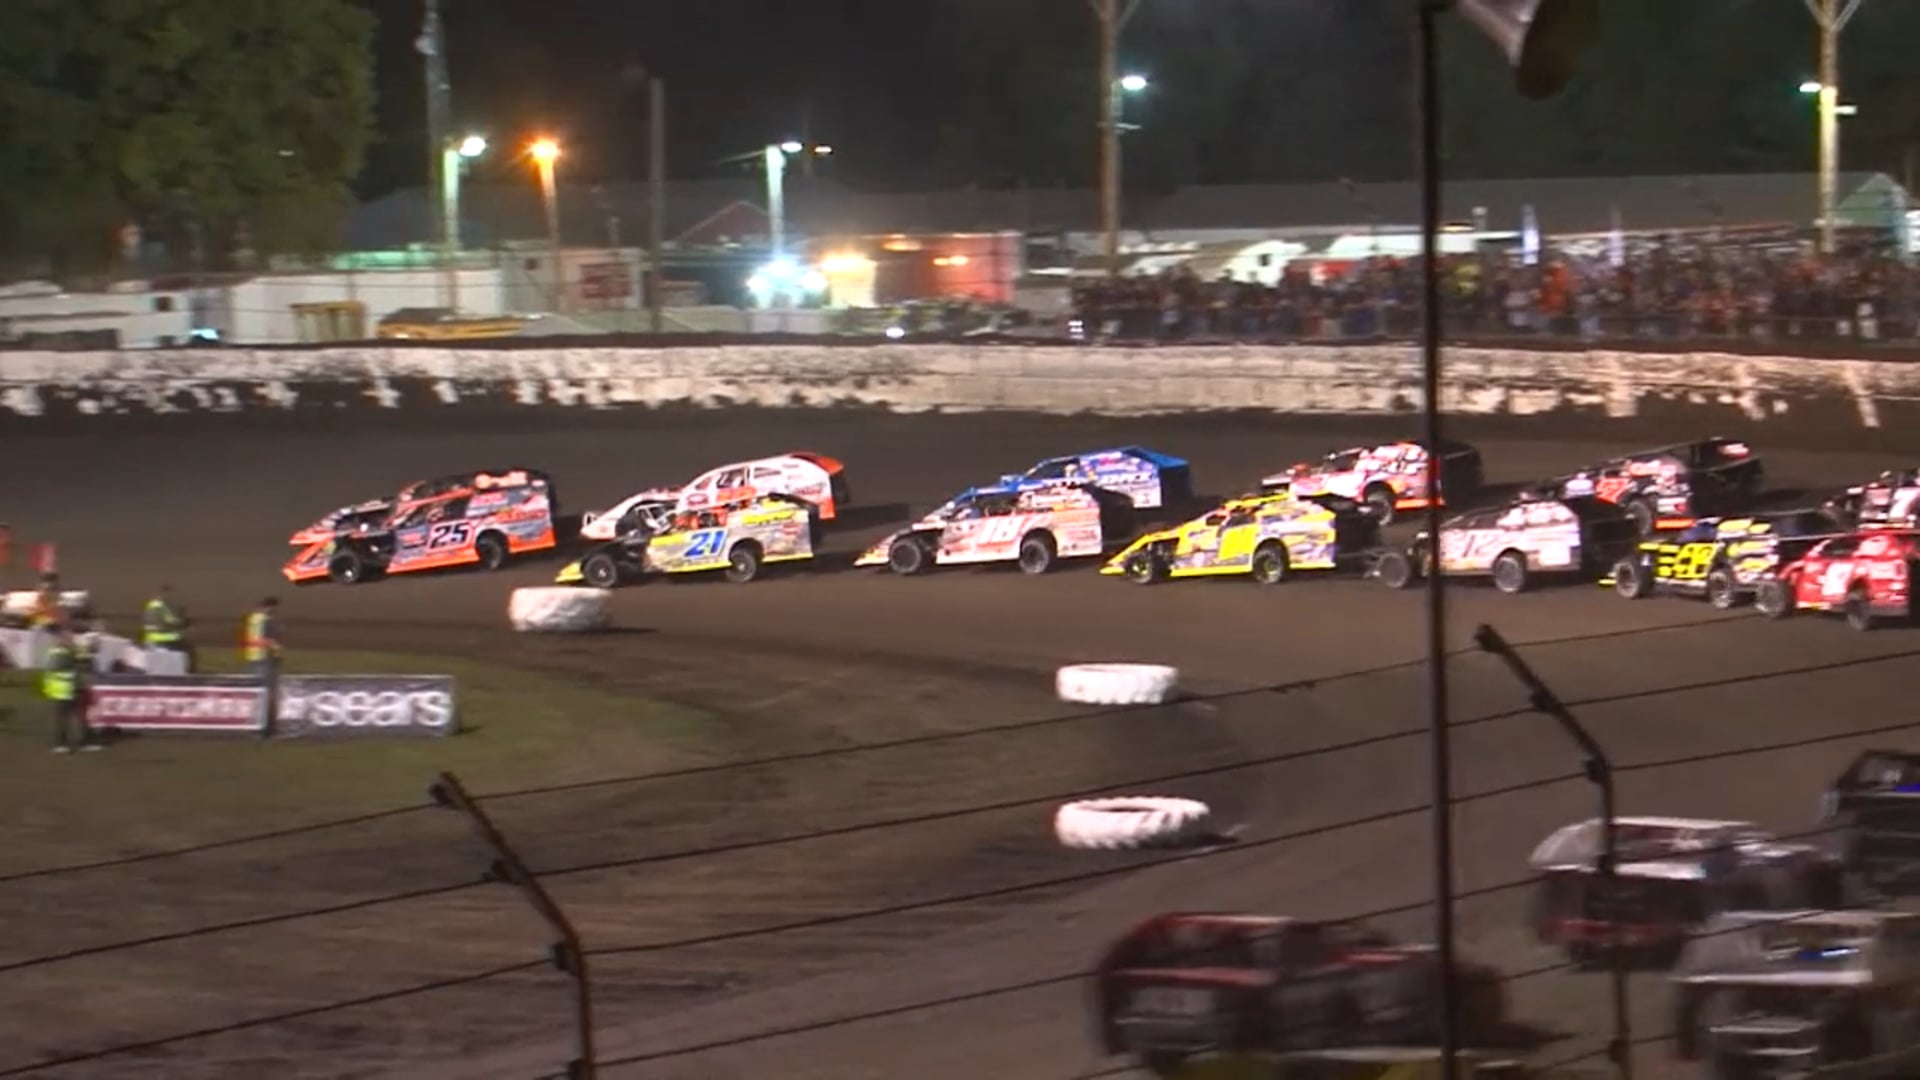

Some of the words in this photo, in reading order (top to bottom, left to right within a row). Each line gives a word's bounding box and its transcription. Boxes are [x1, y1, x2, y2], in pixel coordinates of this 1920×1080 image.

[430, 522, 470, 549] 25
[683, 530, 725, 558] 21
[311, 690, 452, 727] sears
